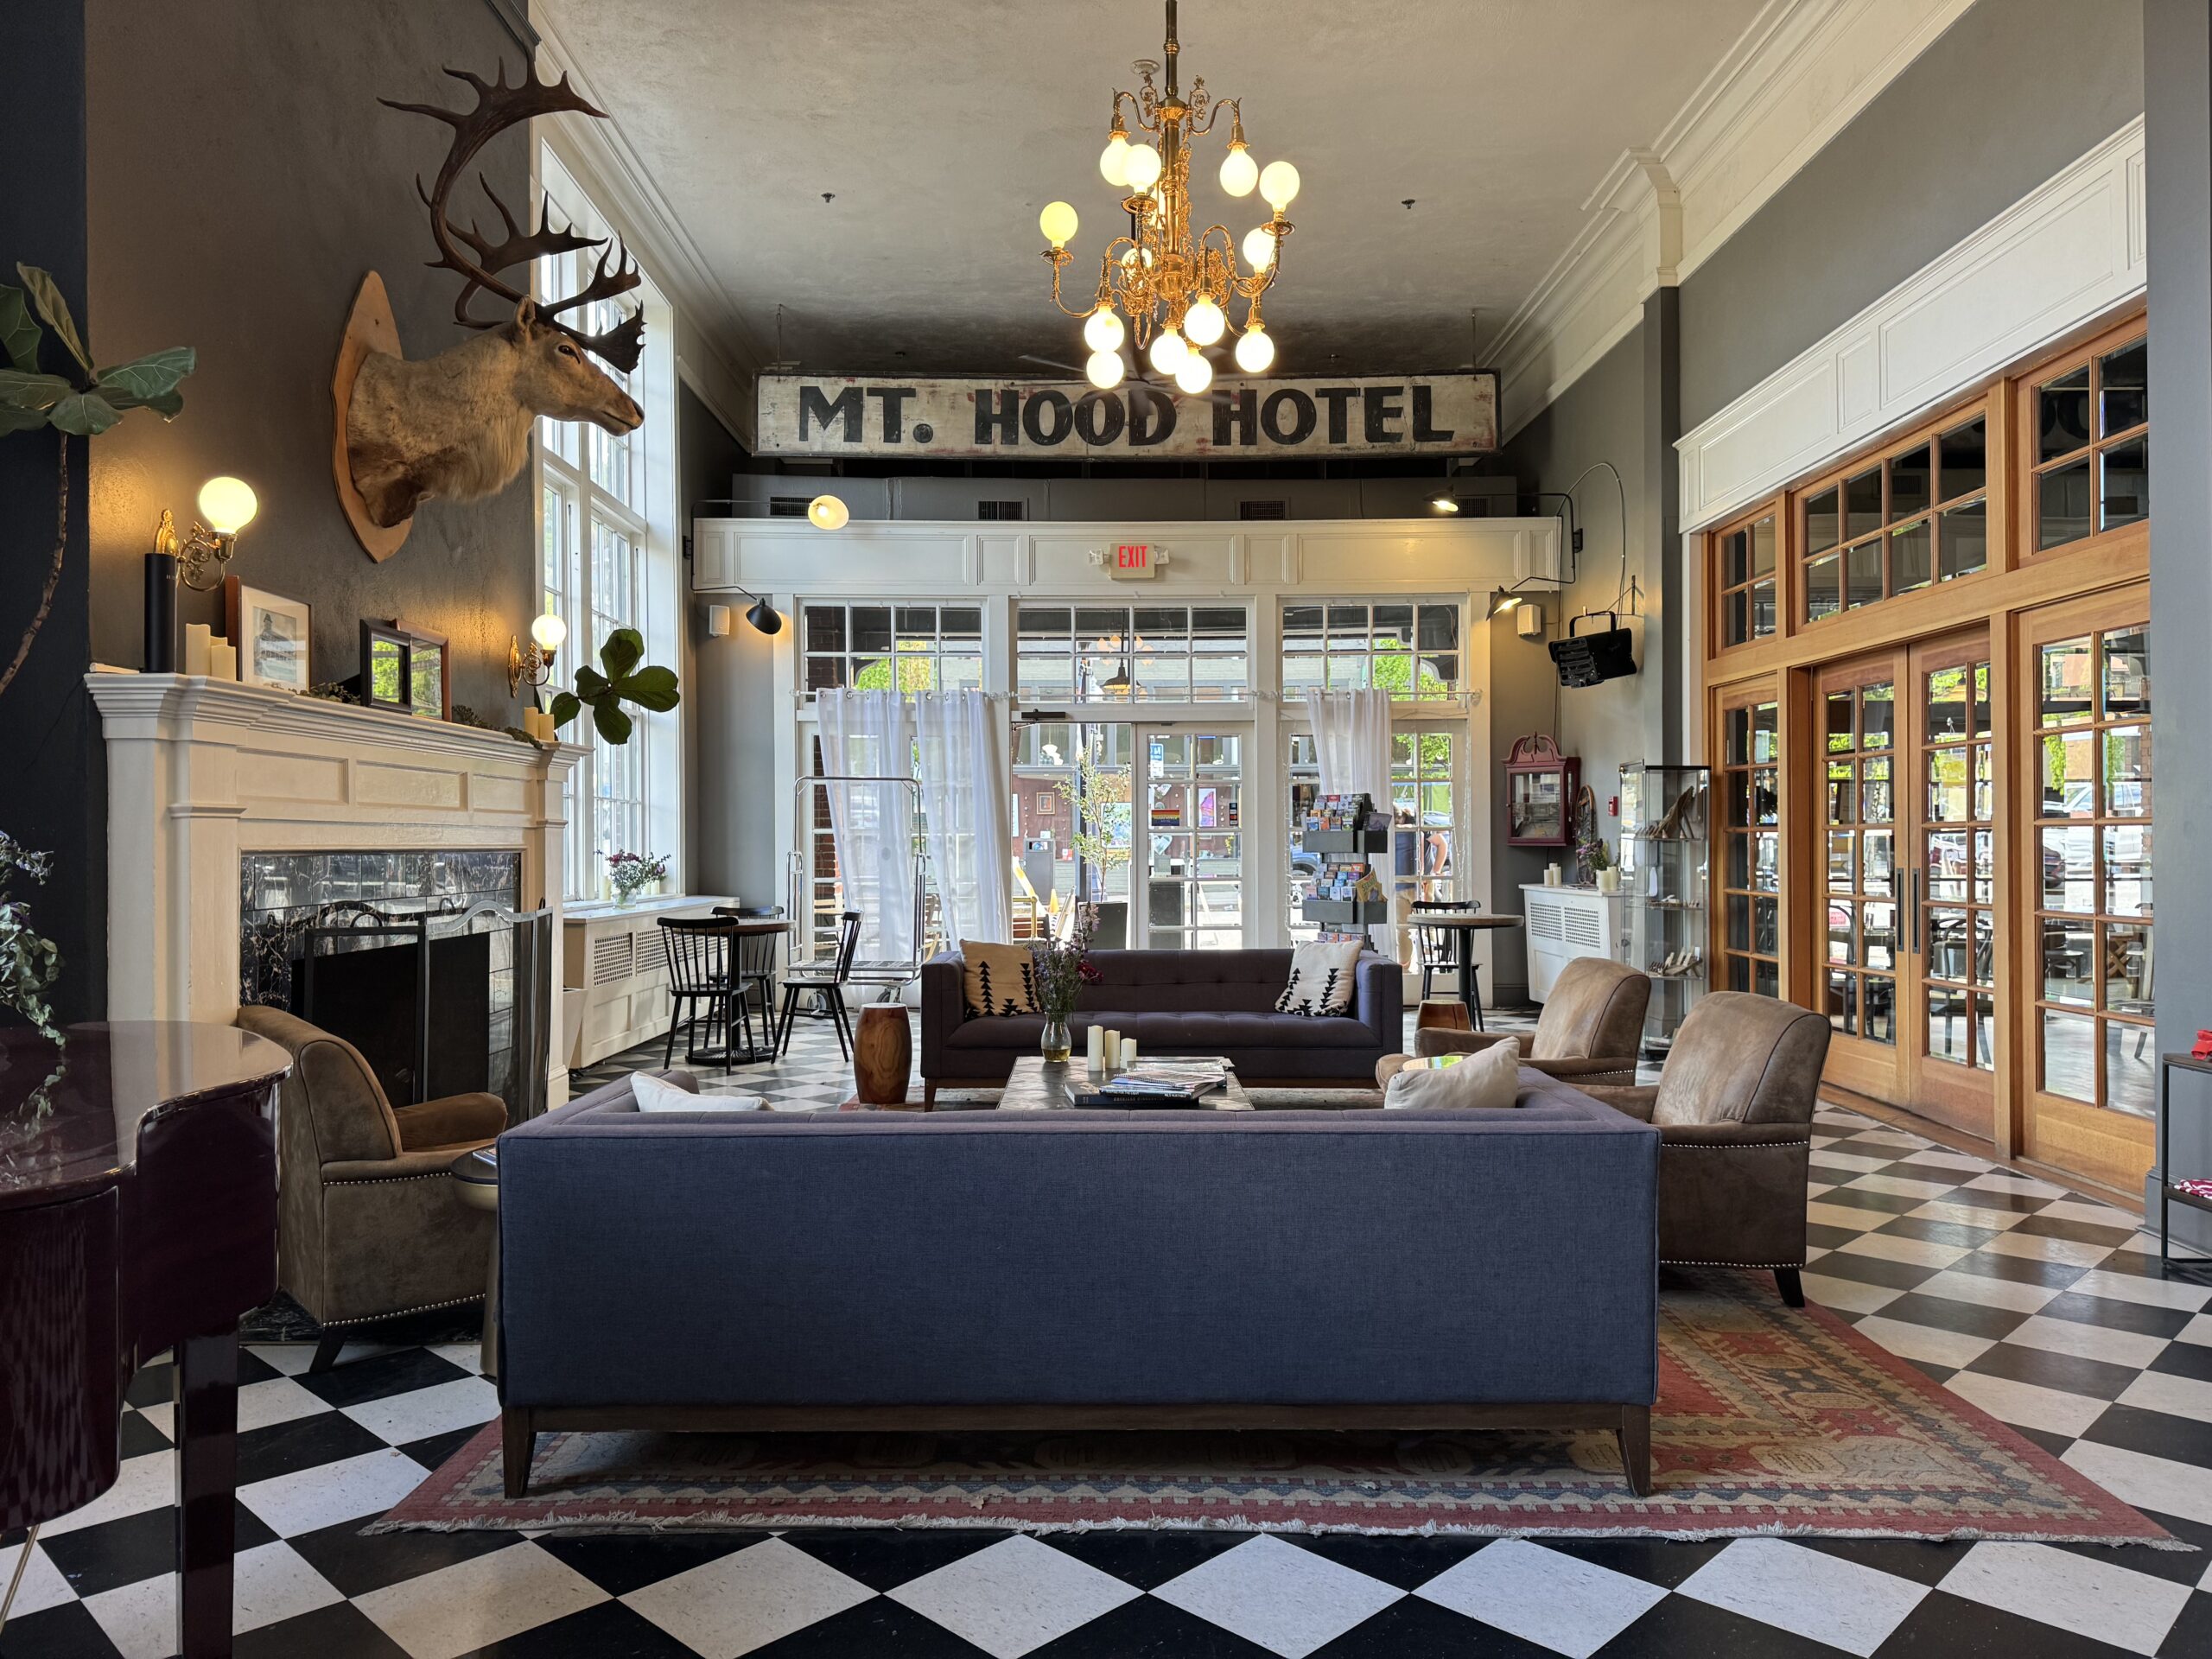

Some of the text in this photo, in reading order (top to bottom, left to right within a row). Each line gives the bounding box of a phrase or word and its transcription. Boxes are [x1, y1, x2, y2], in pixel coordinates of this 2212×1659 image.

[798, 385, 1454, 446] MT. HOOD HOTEL
[1119, 545, 1147, 568] EXIT
